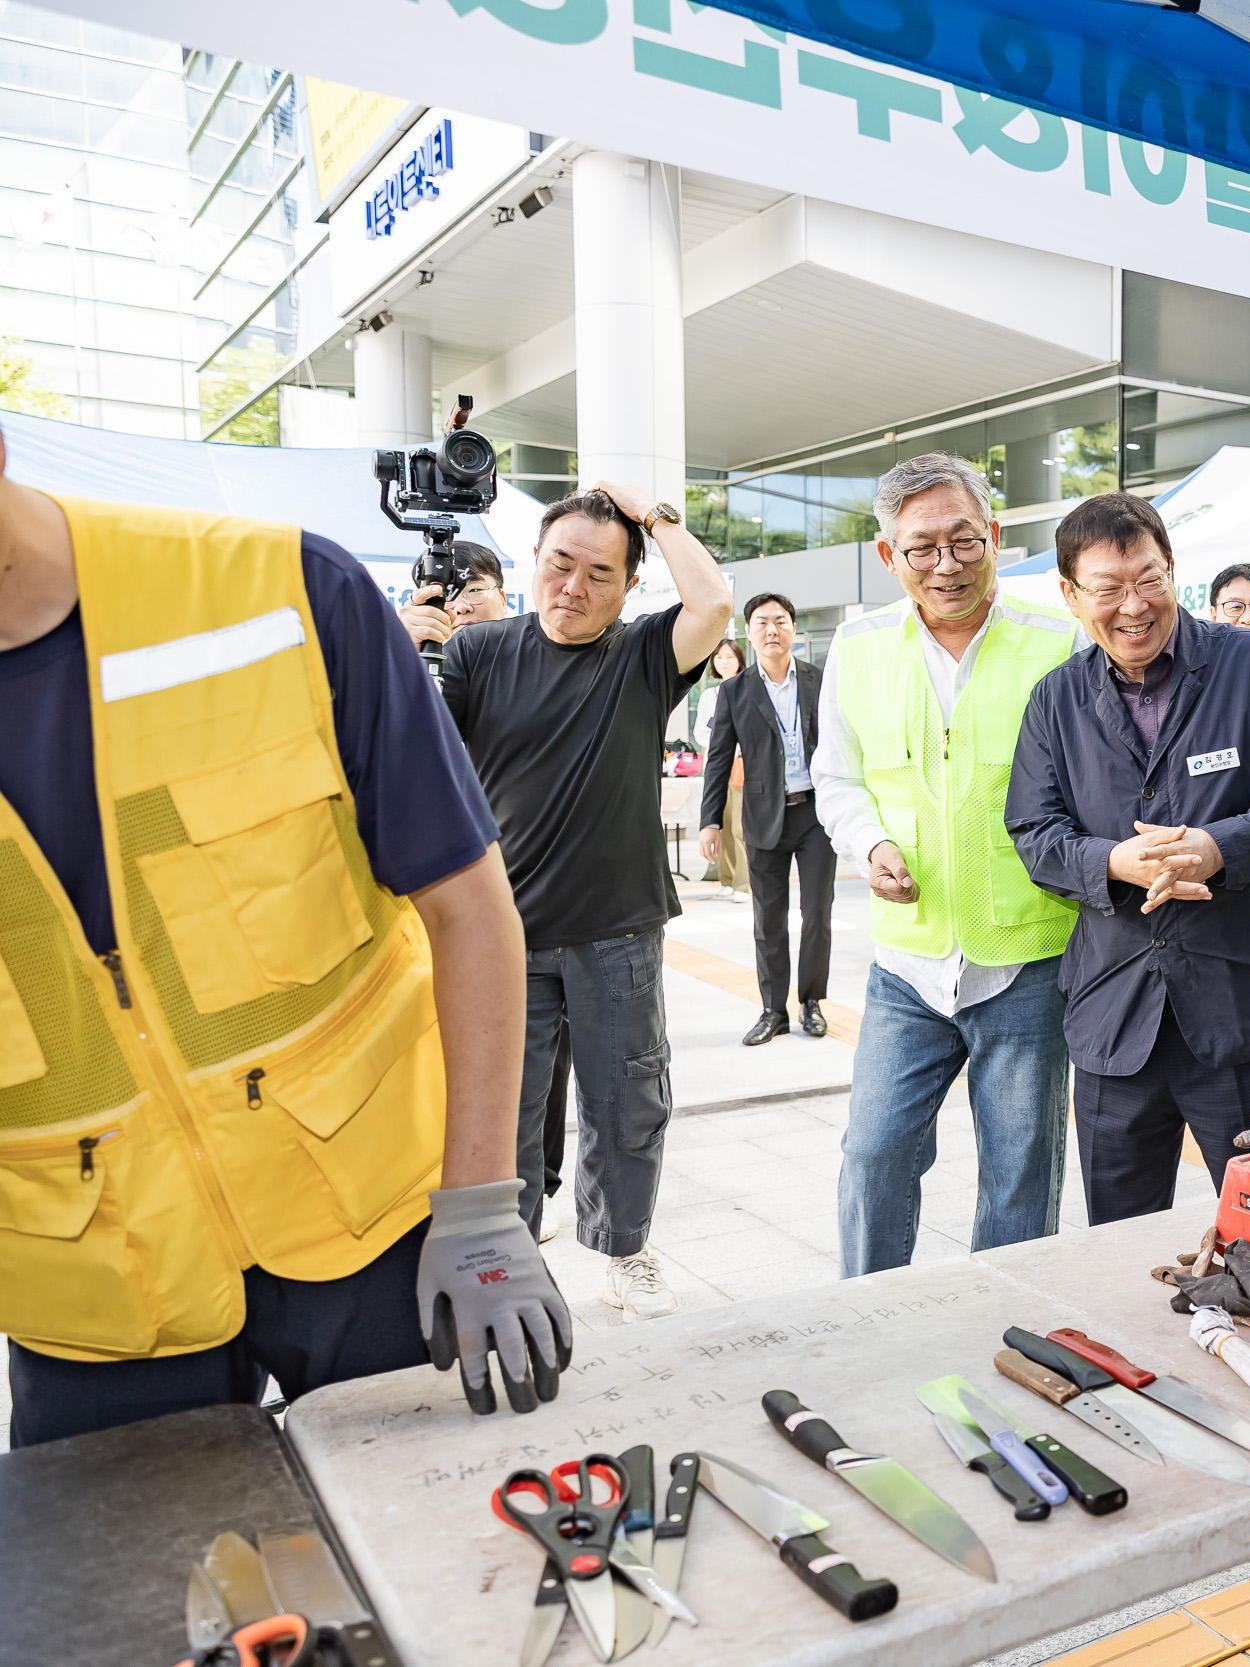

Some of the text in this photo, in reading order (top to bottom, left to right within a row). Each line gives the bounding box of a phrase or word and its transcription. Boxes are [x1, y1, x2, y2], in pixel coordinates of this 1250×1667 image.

[365, 119, 453, 240] 나루아트센터
[456, 1254, 511, 1273] Comfort Grip
[464, 1249, 496, 1260] Gloves
[477, 1268, 509, 1285] 3M
